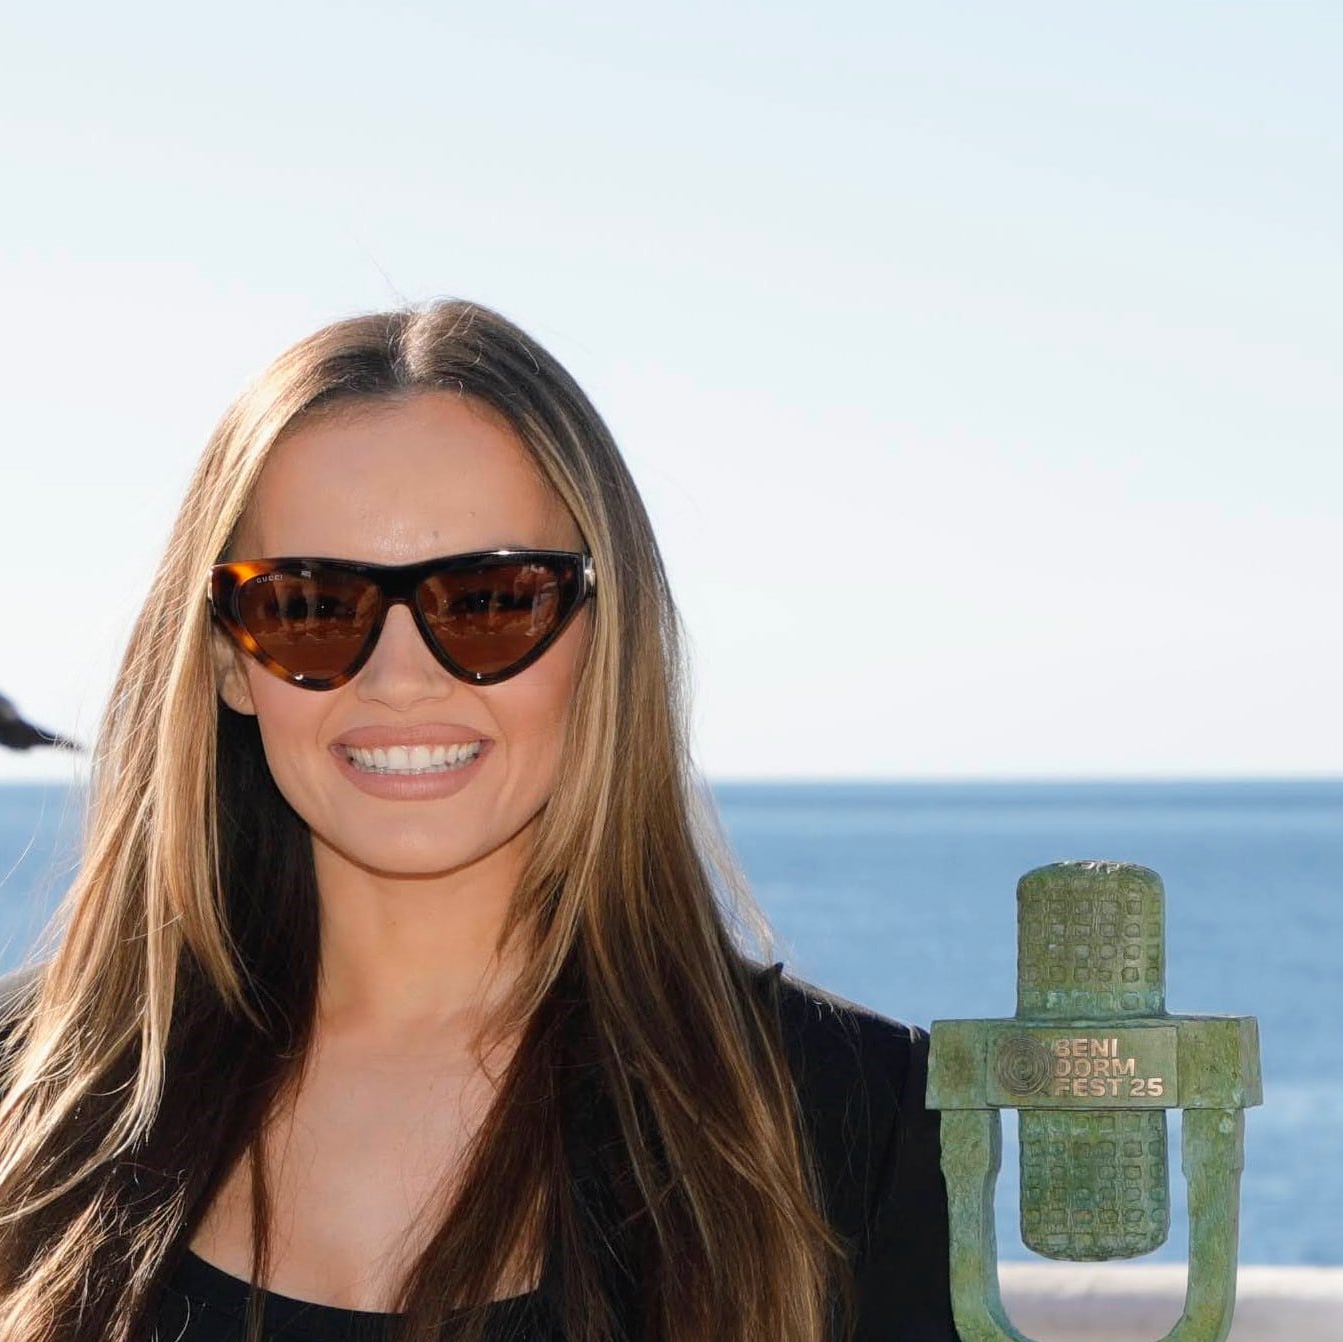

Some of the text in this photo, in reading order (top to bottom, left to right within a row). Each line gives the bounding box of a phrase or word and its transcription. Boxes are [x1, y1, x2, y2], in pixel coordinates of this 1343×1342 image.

[256, 574, 283, 584] GUCCI
[1054, 1038, 1118, 1058] BENI
[1054, 1058, 1135, 1077] DORM
[1054, 1077, 1164, 1097] FEST 25
